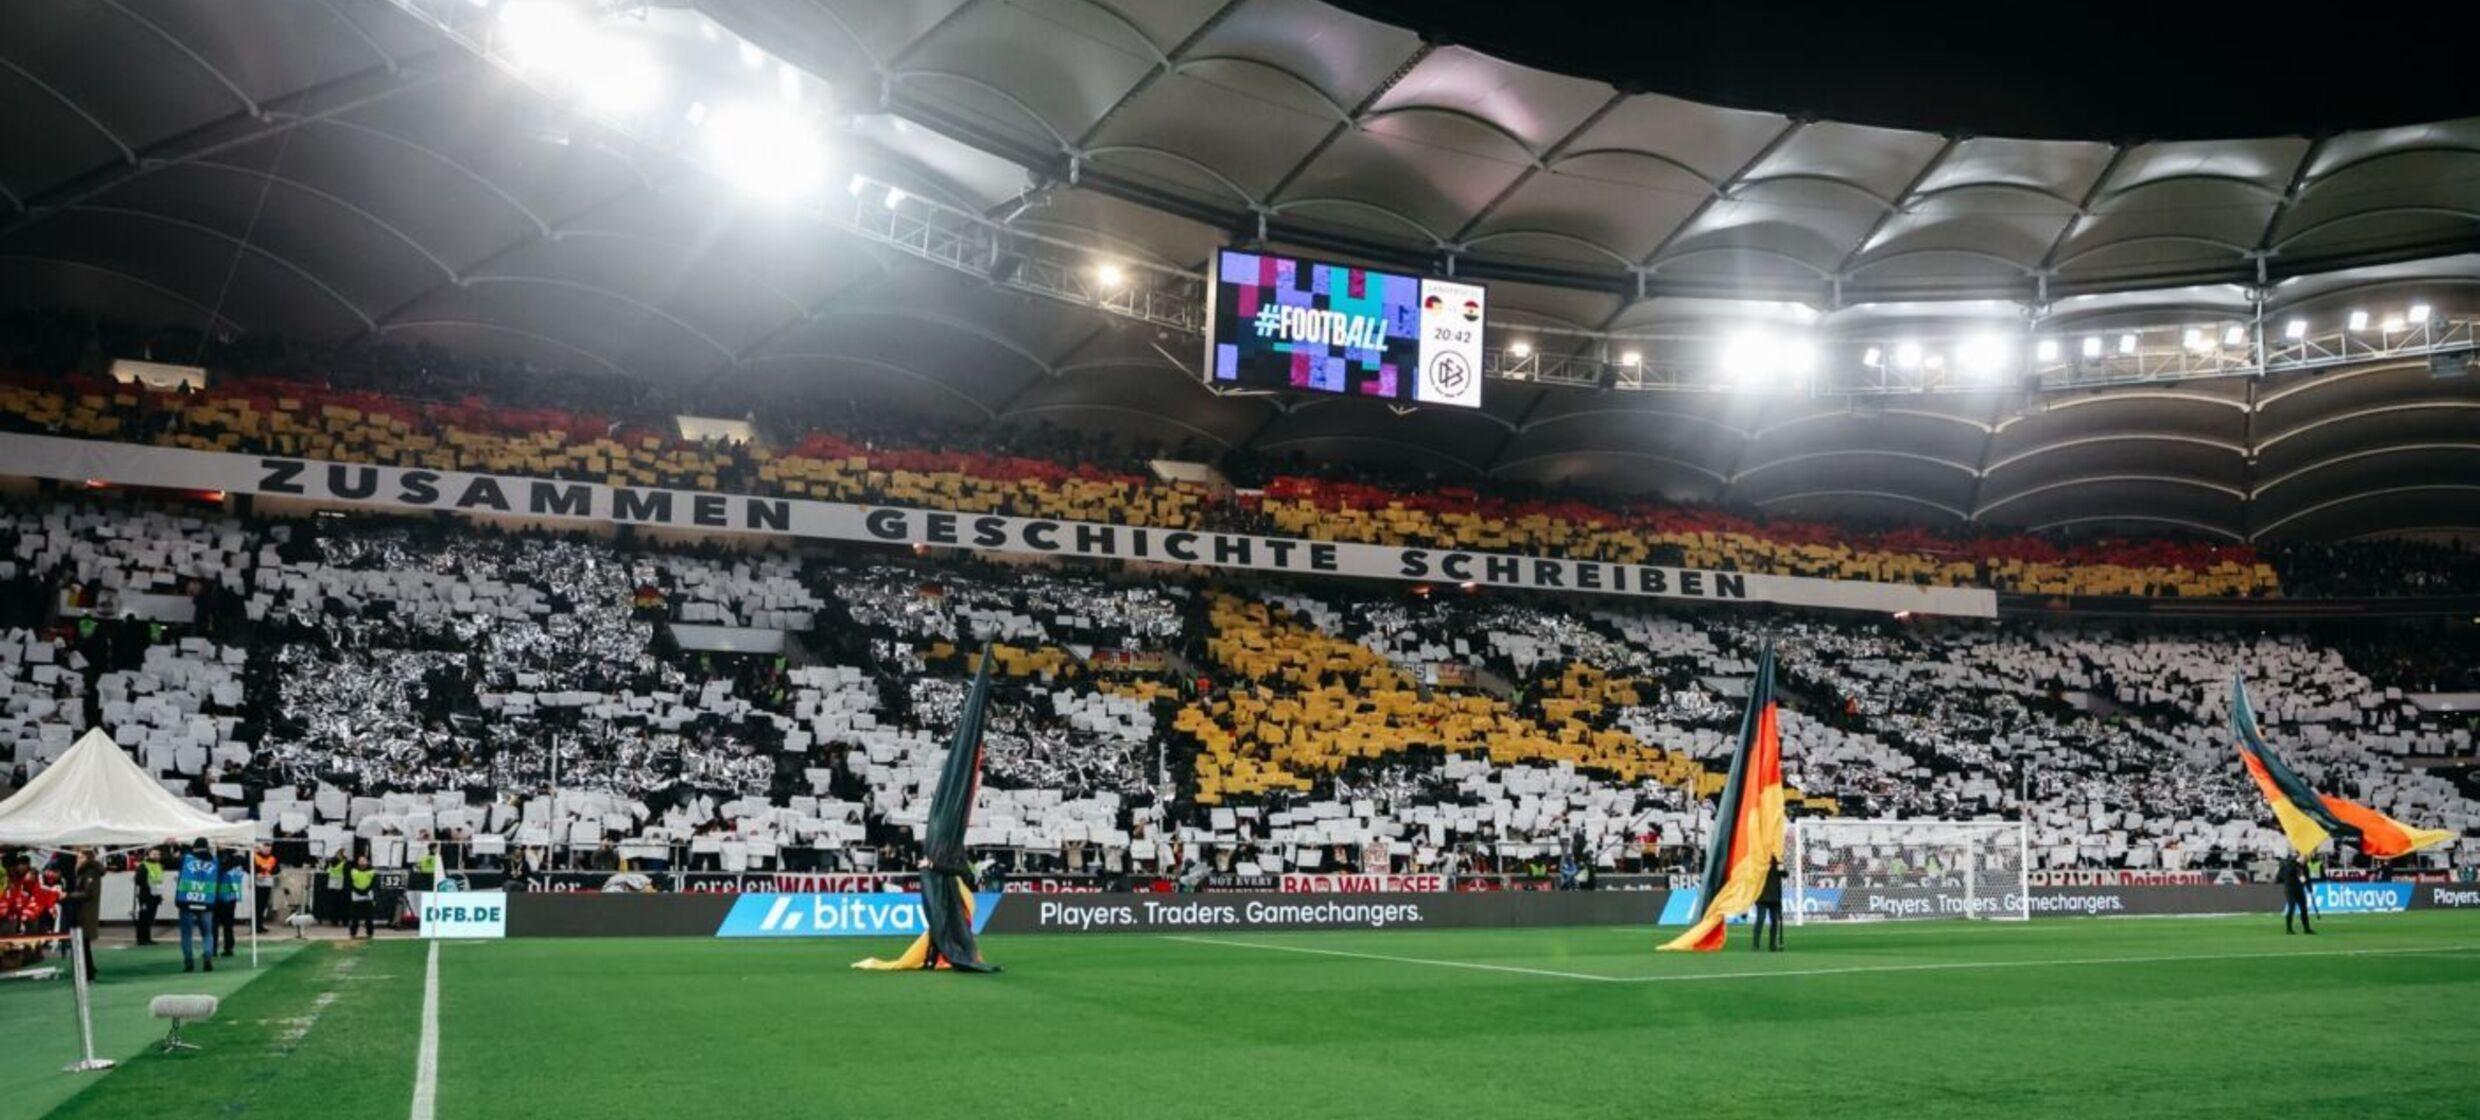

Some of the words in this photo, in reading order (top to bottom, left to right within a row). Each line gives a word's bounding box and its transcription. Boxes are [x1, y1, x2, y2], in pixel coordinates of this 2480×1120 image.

[1254, 303, 1388, 351] #FOOTBALL
[1435, 328, 1471, 343] 20:42
[258, 459, 790, 530] ZUSAMMEN
[866, 509, 1338, 571] GESCHICHTE
[1401, 549, 1746, 598] SCHREIBEN
[1869, 894, 1933, 917] Players.
[2004, 893, 2125, 915] Gamechangers.
[2327, 884, 2398, 907] bitvavo
[426, 907, 501, 922] DFB.DE
[814, 895, 929, 929] bitvav
[1040, 902, 1138, 930] Players.
[1144, 902, 1240, 924] Traders.
[1246, 901, 1424, 926] Gamechangers.
